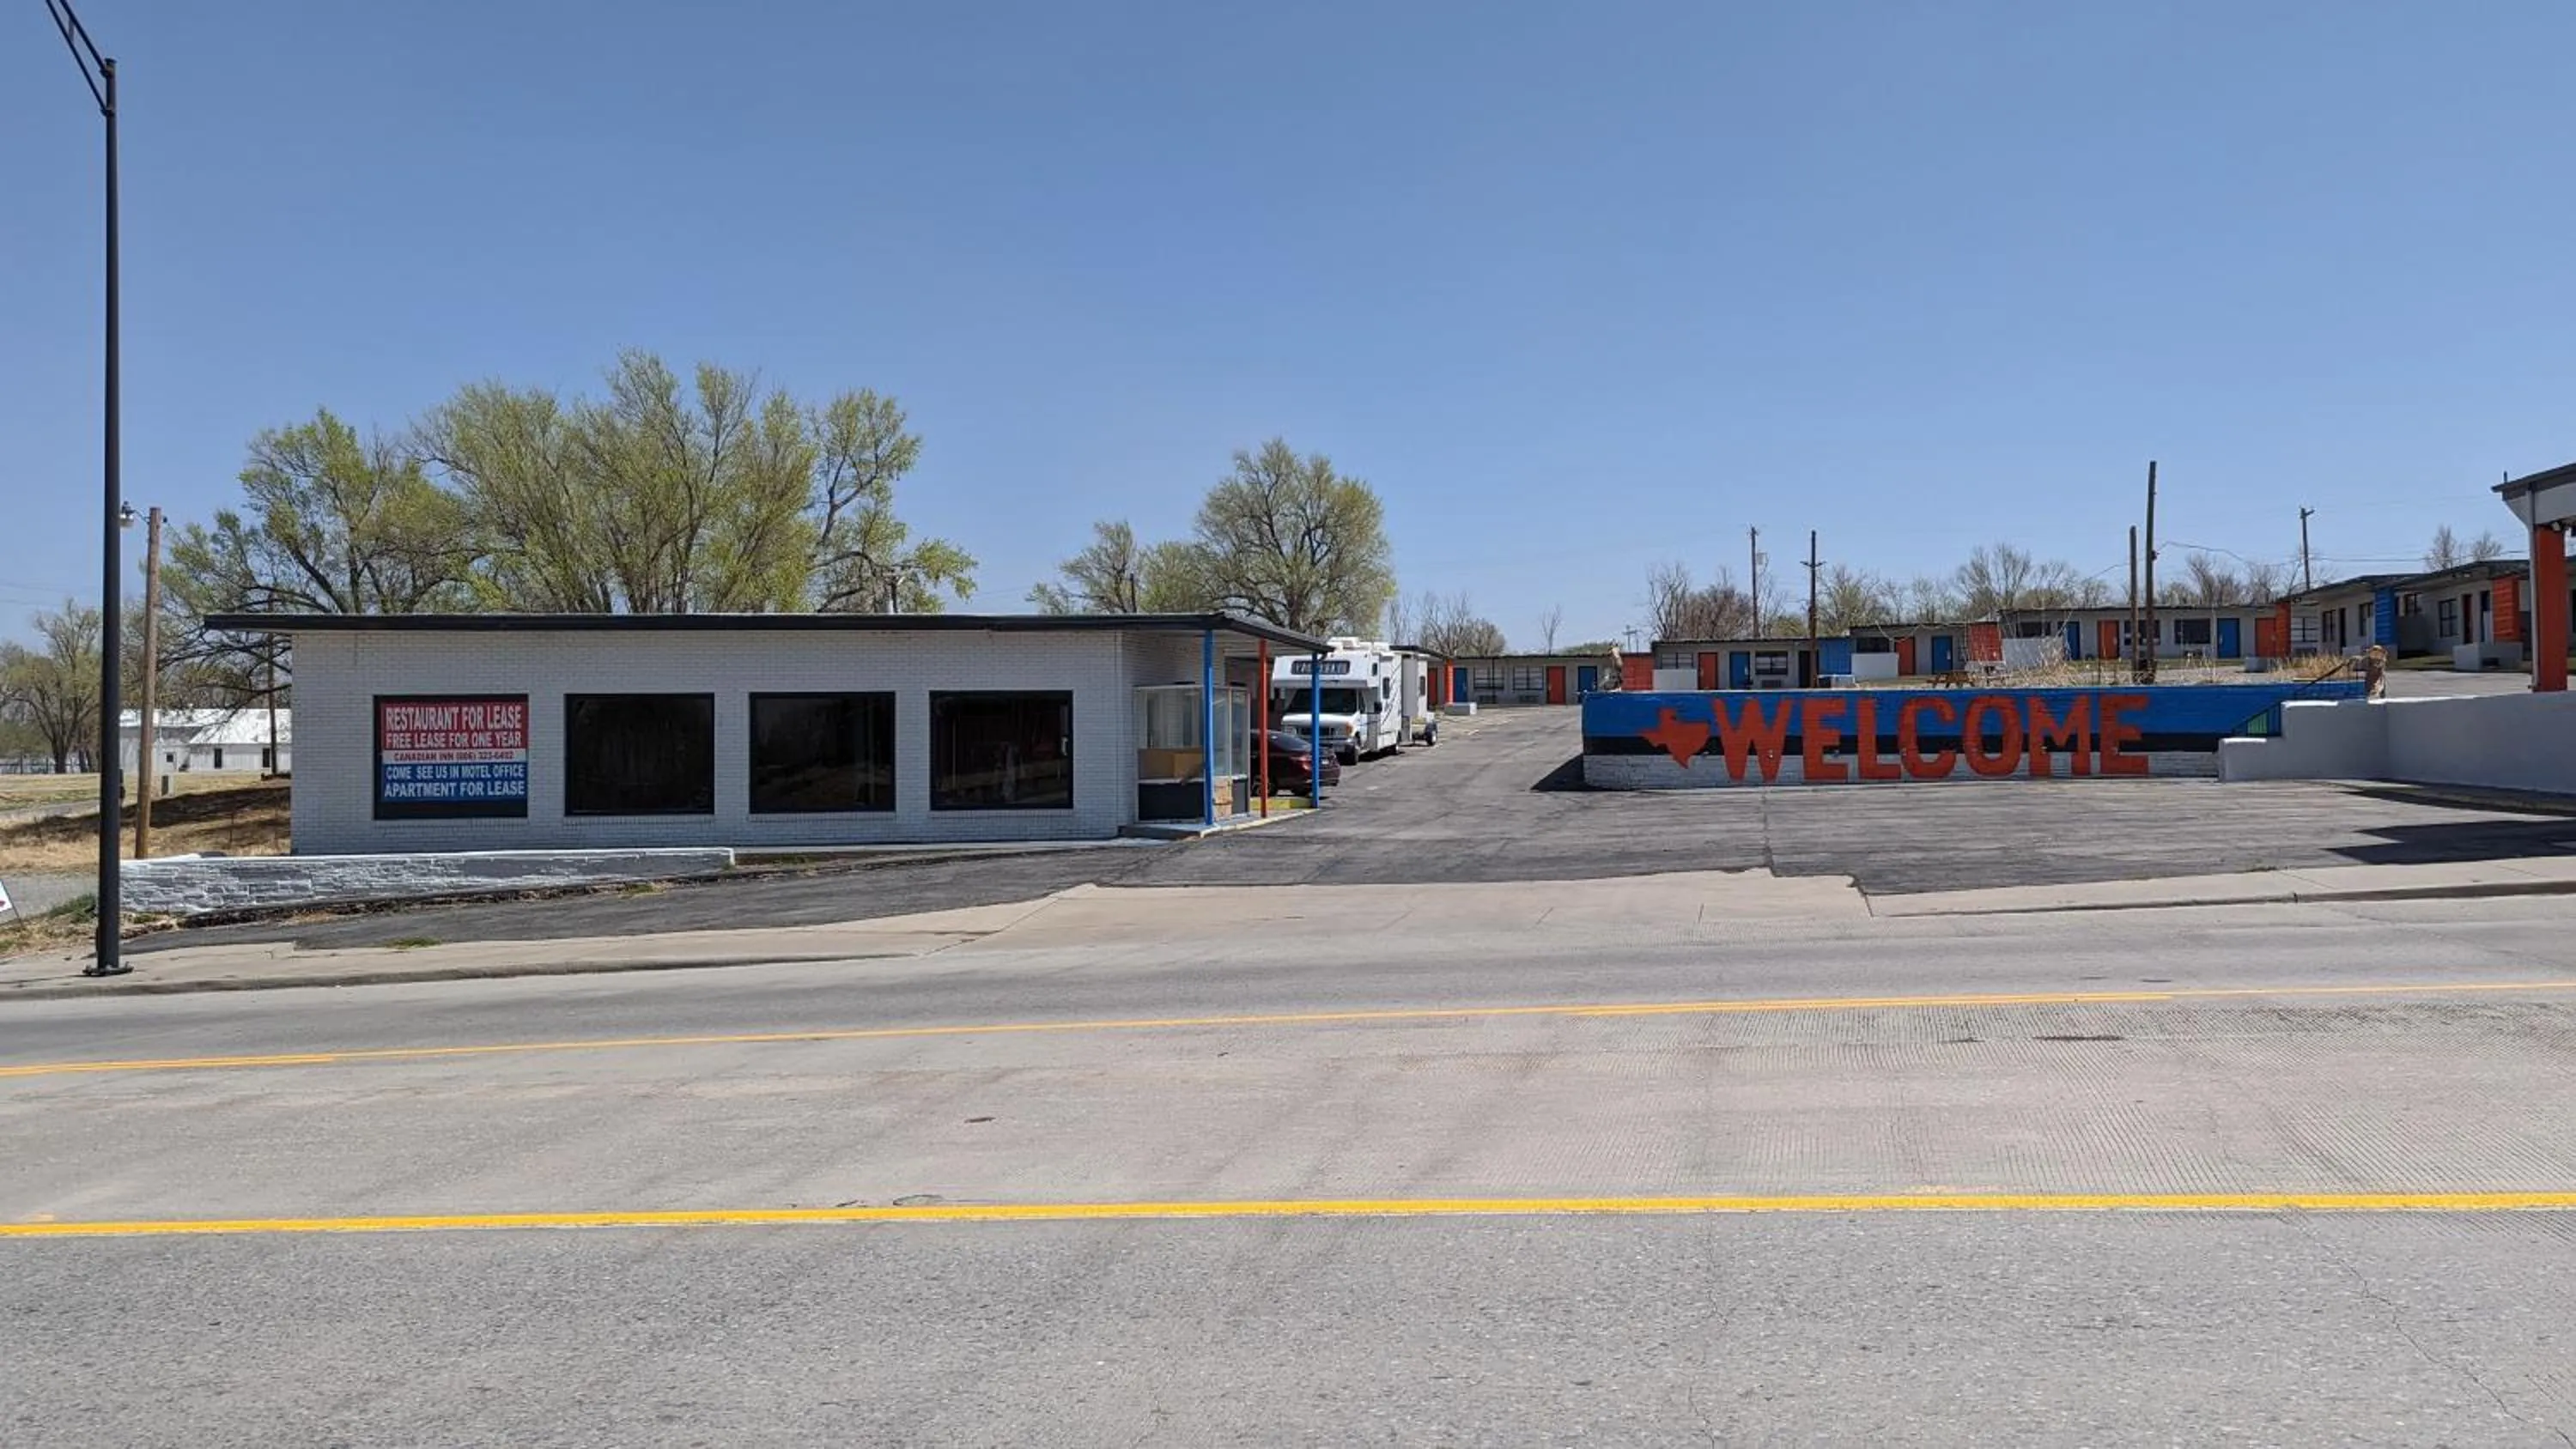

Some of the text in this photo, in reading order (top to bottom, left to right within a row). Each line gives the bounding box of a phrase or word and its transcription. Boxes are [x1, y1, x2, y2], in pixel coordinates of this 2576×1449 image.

[386, 705, 522, 731] RESTAURANT FOR LEASE
[386, 731, 521, 749] FREE LEASE FOR ONE YEAR
[1710, 694, 2149, 783] WELCOME
[394, 751, 436, 761] CANADIAN
[439, 751, 453, 761] INN
[386, 764, 525, 779] COME SEE US IN MOTEL OFFICE
[385, 780, 526, 797] APARTMENT FOR LEASE
